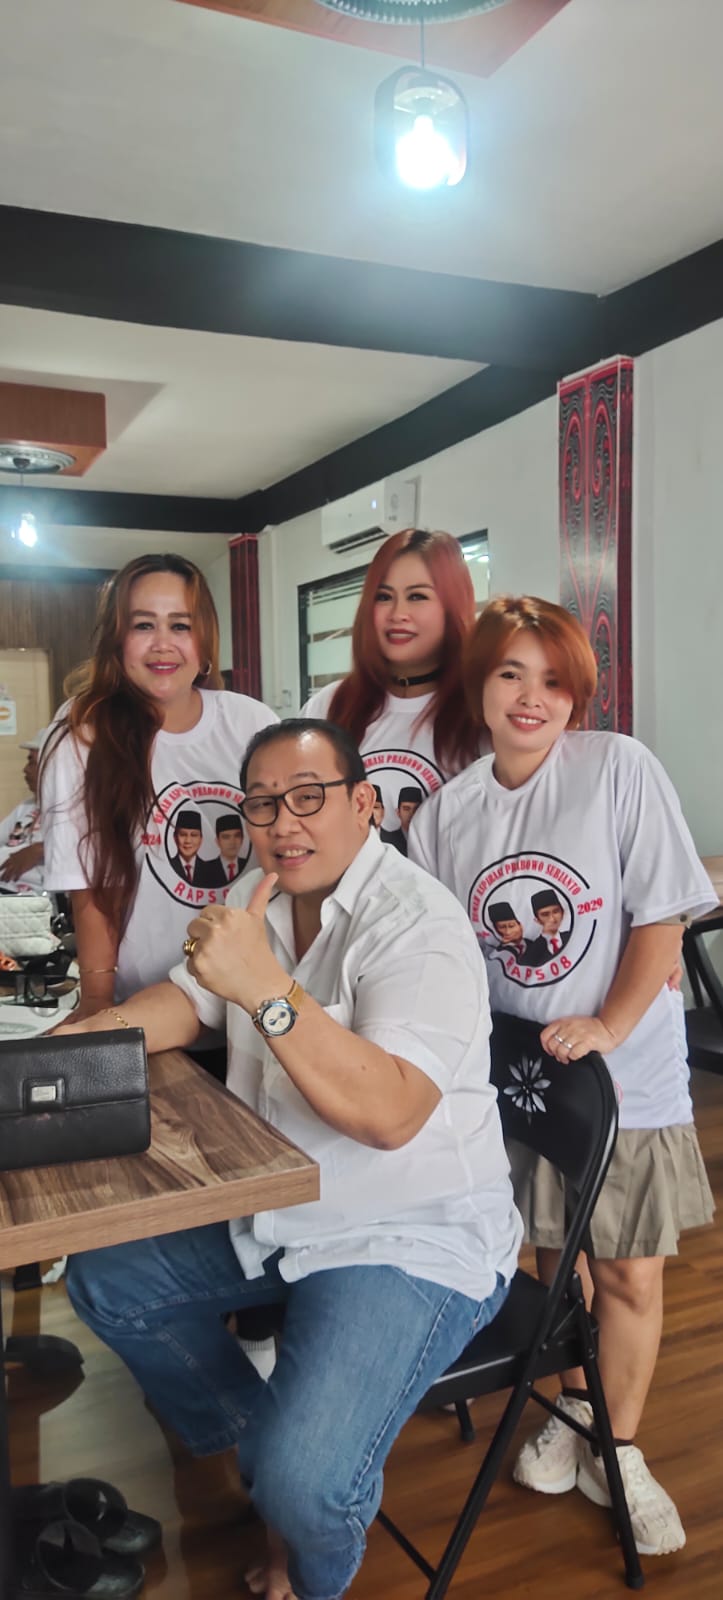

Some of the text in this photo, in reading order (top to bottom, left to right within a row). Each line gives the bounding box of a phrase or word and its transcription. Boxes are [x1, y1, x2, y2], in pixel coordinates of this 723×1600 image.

[504, 859, 545, 875] PRABOWO
[545, 863, 582, 896] SUBIANTO
[174, 881, 217, 903] RAPS
[577, 897, 604, 915] 2029
[506, 955, 571, 981] RAPS 08
